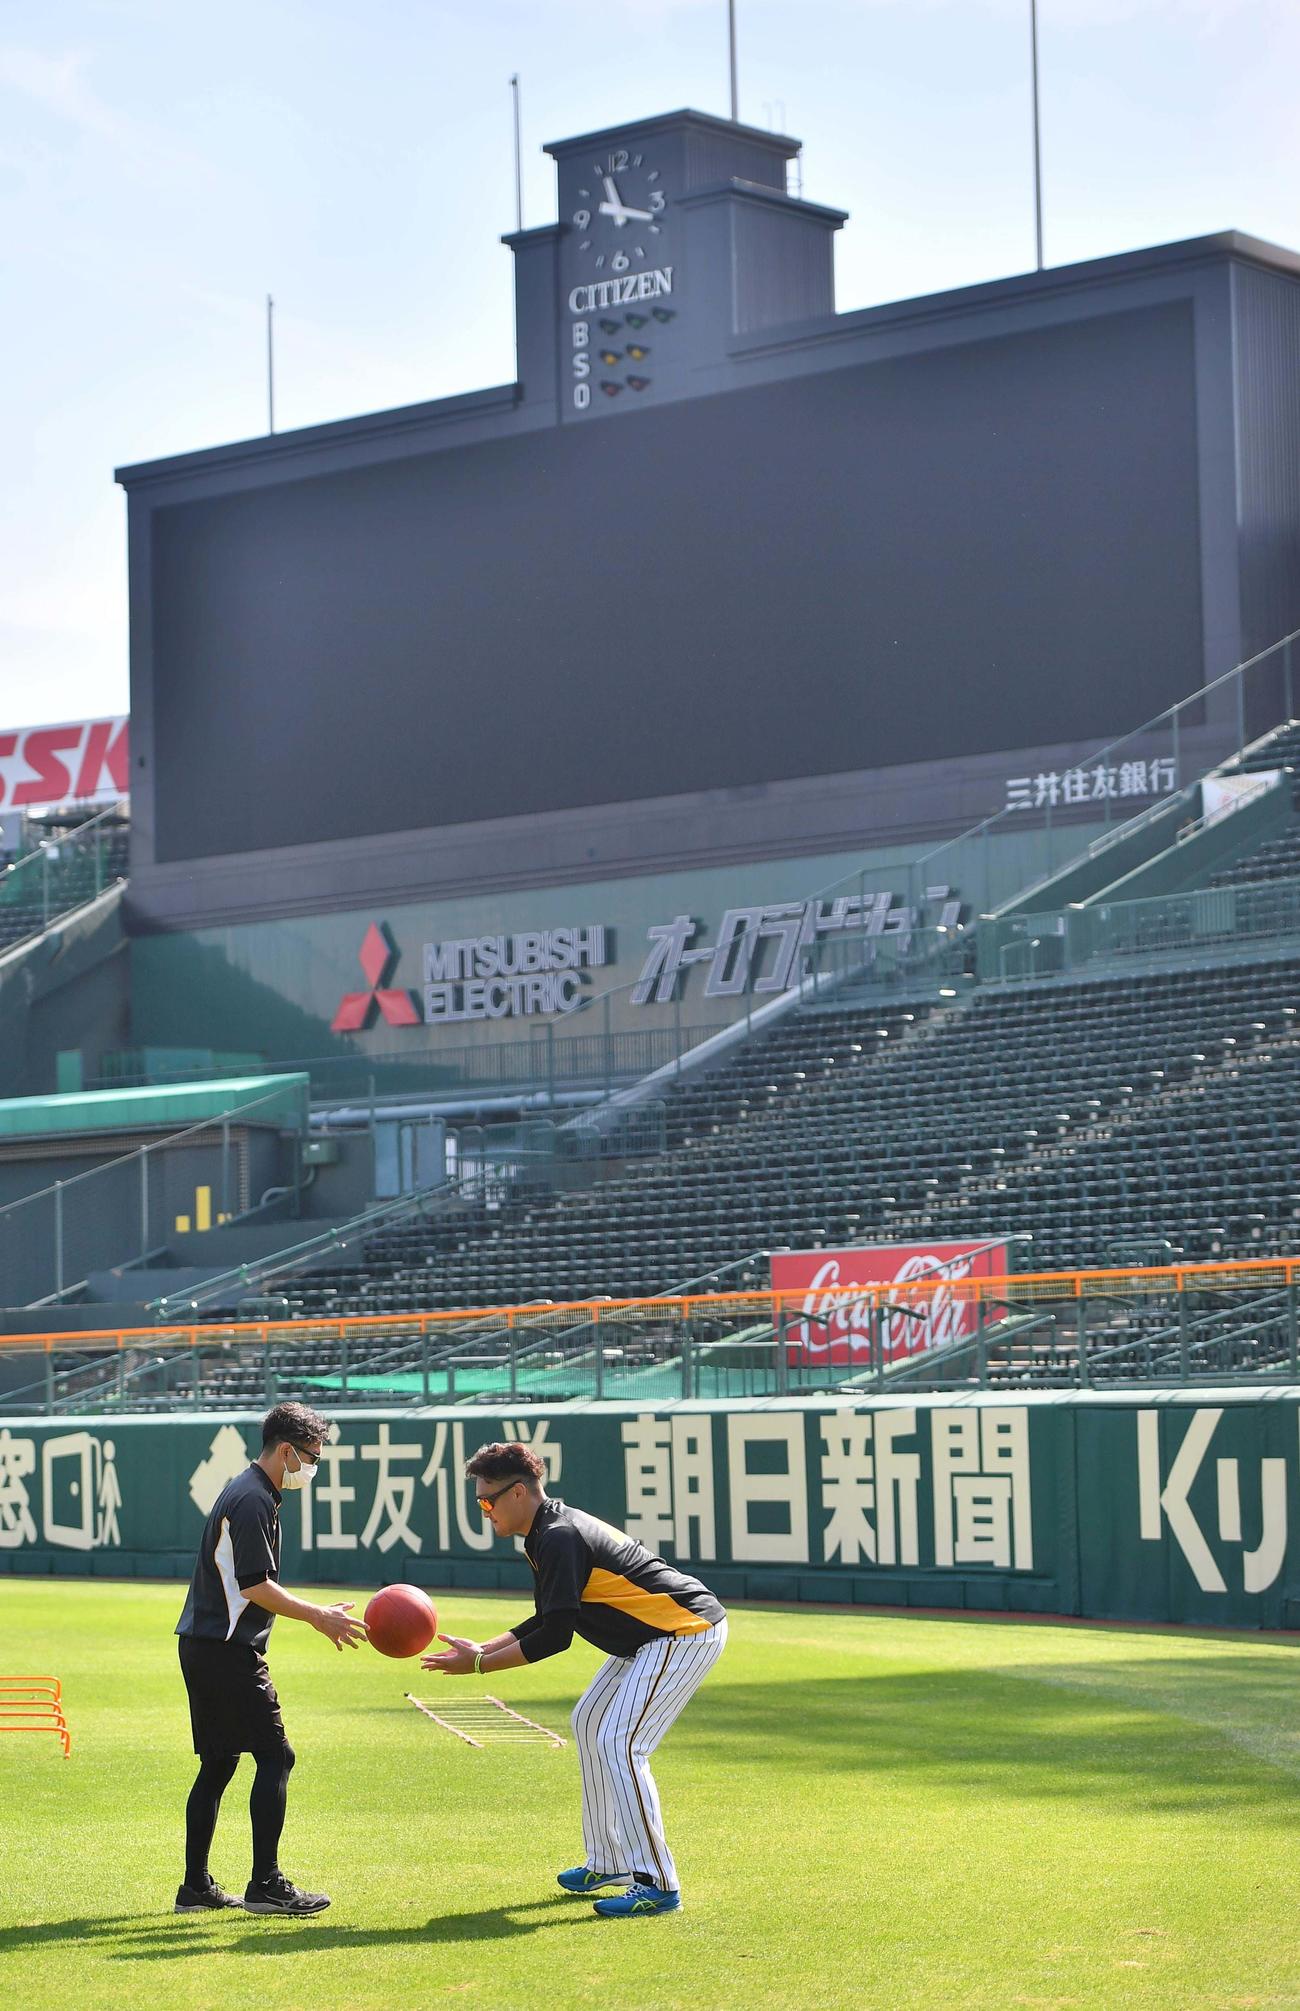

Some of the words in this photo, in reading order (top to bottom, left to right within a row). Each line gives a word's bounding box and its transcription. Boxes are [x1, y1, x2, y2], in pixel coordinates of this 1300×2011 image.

[573, 209, 591, 231] 9
[649, 189, 666, 214] 3
[611, 251, 630, 272] 6
[568, 266, 674, 316] CITIZEN
[1005, 757, 1177, 811] 三井住友銀行
[422, 923, 606, 982] MITSUBISHI
[423, 970, 583, 1024] ELECTRIC
[620, 1406, 1034, 1571] 朝日新聞
